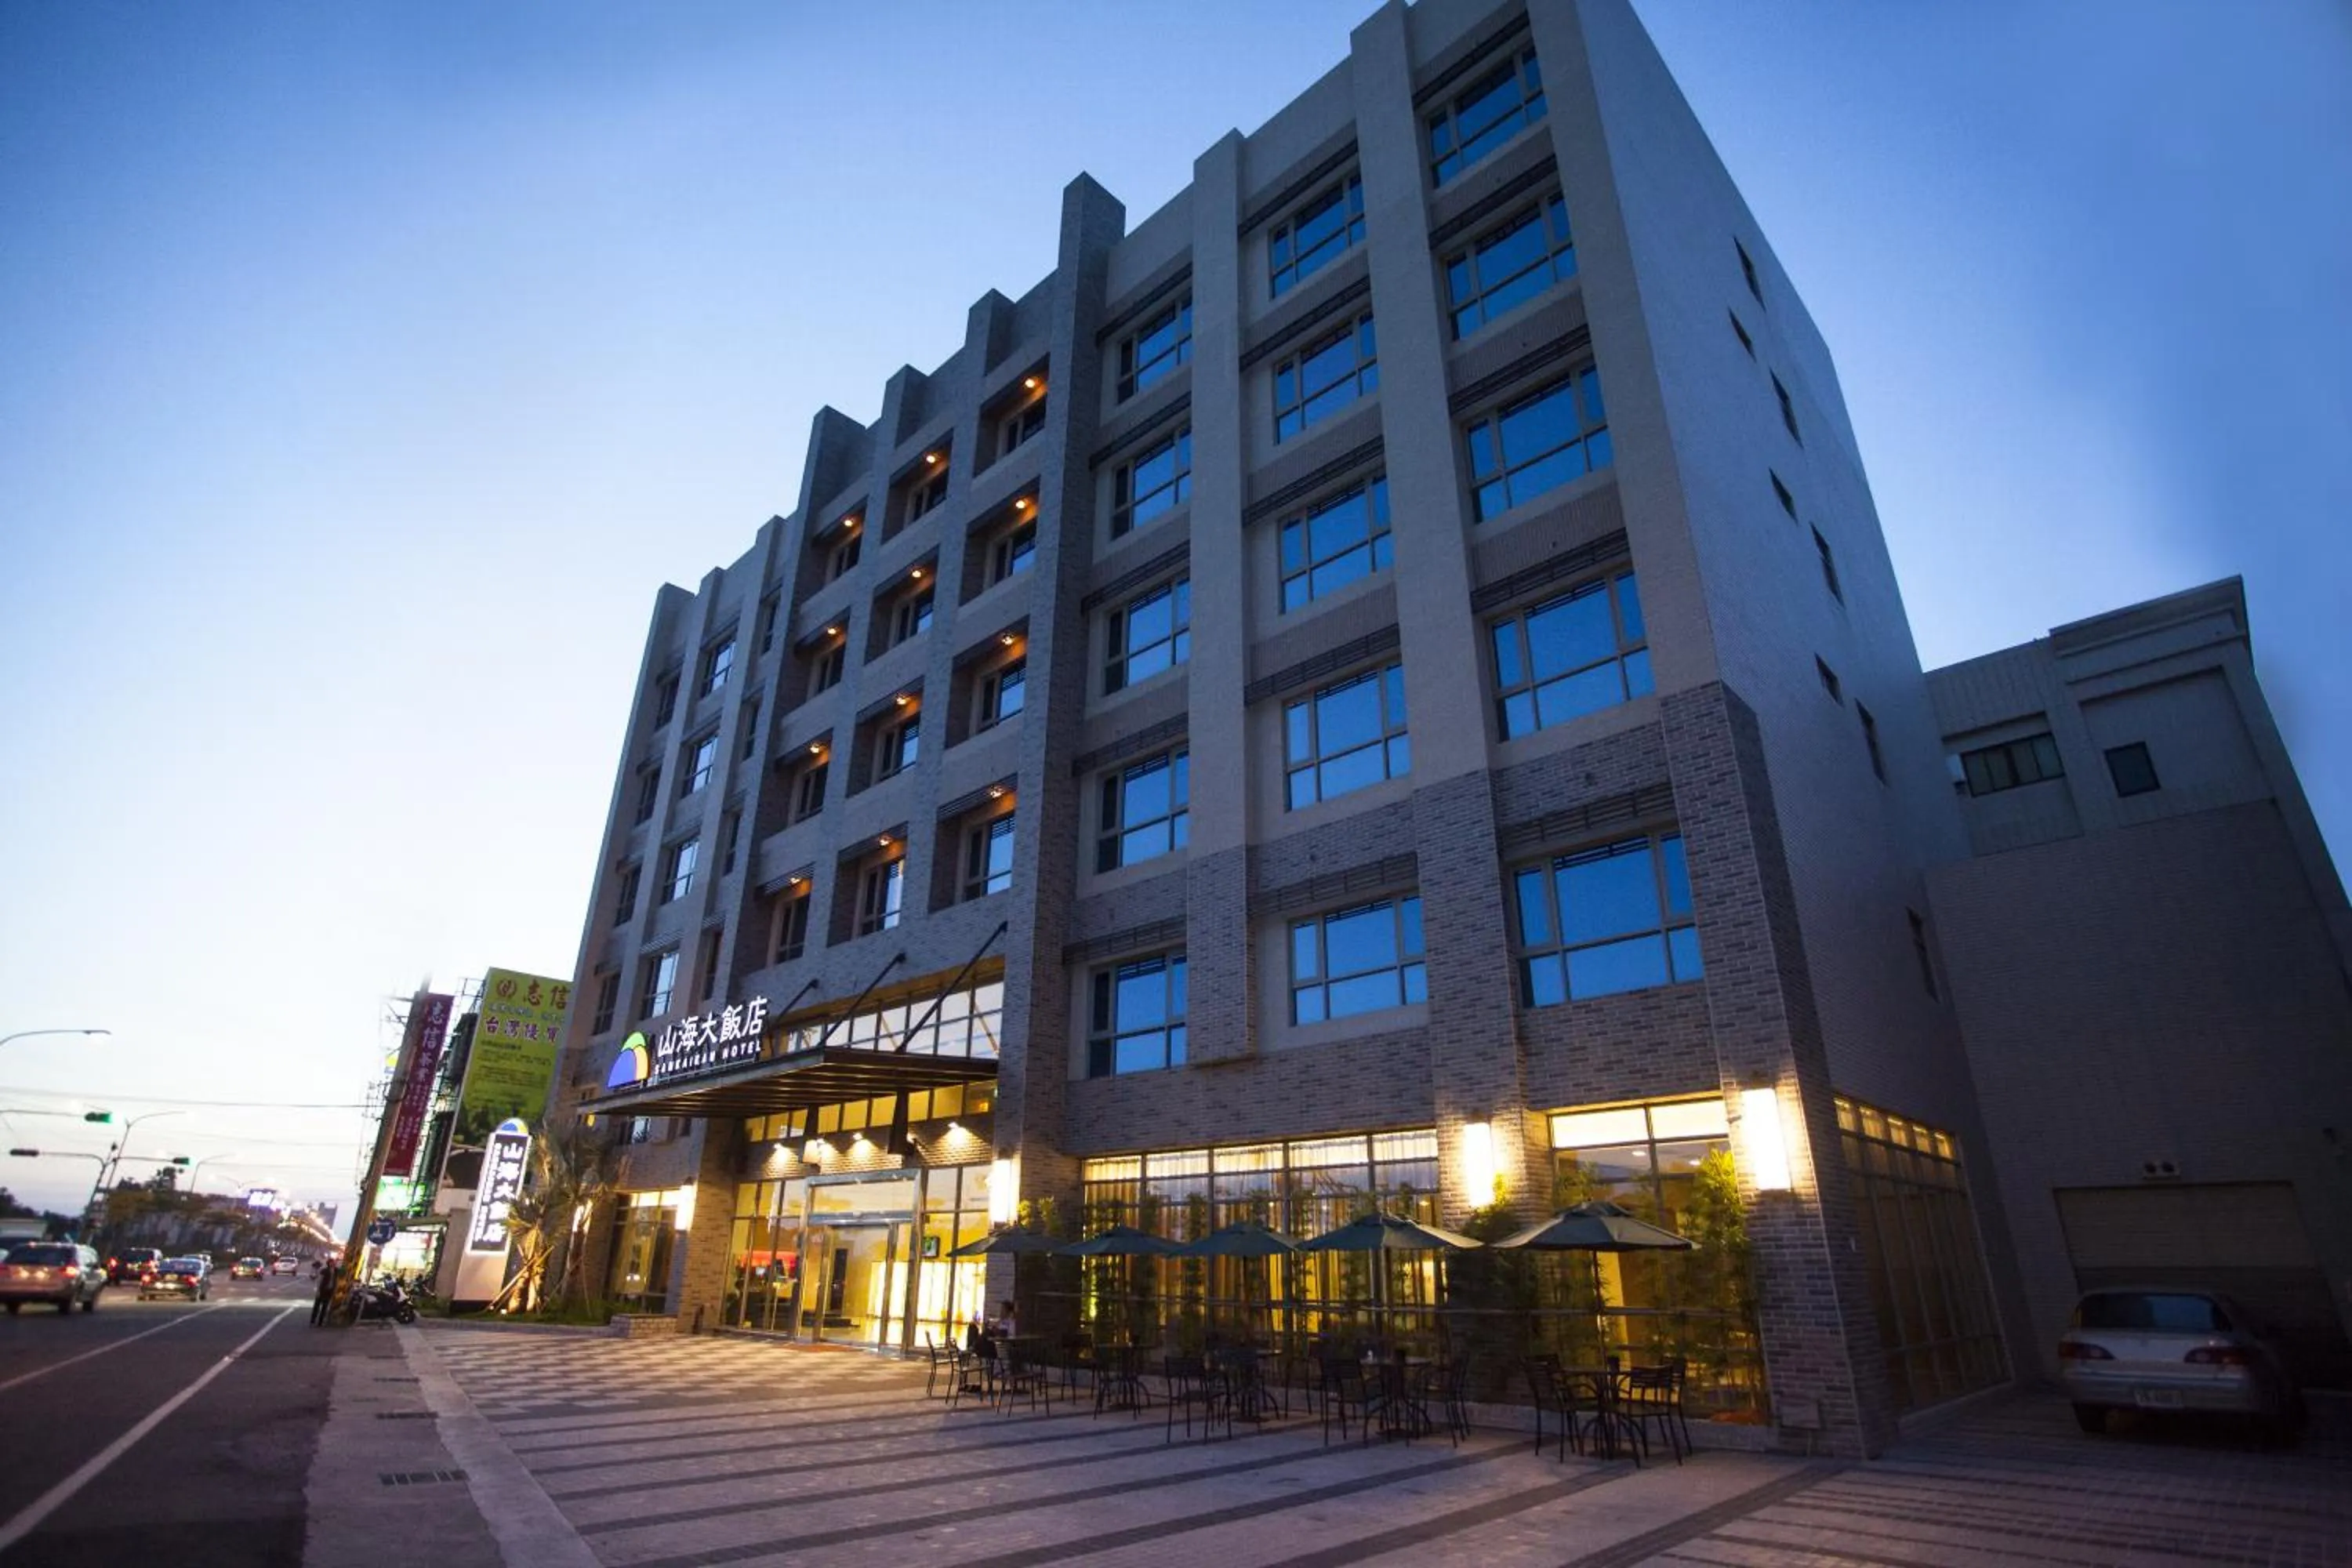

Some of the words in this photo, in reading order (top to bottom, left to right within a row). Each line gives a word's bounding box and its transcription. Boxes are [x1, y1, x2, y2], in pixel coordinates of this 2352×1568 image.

[658, 995, 768, 1058] 山海大飯店
[722, 1039, 762, 1059] HOTEL
